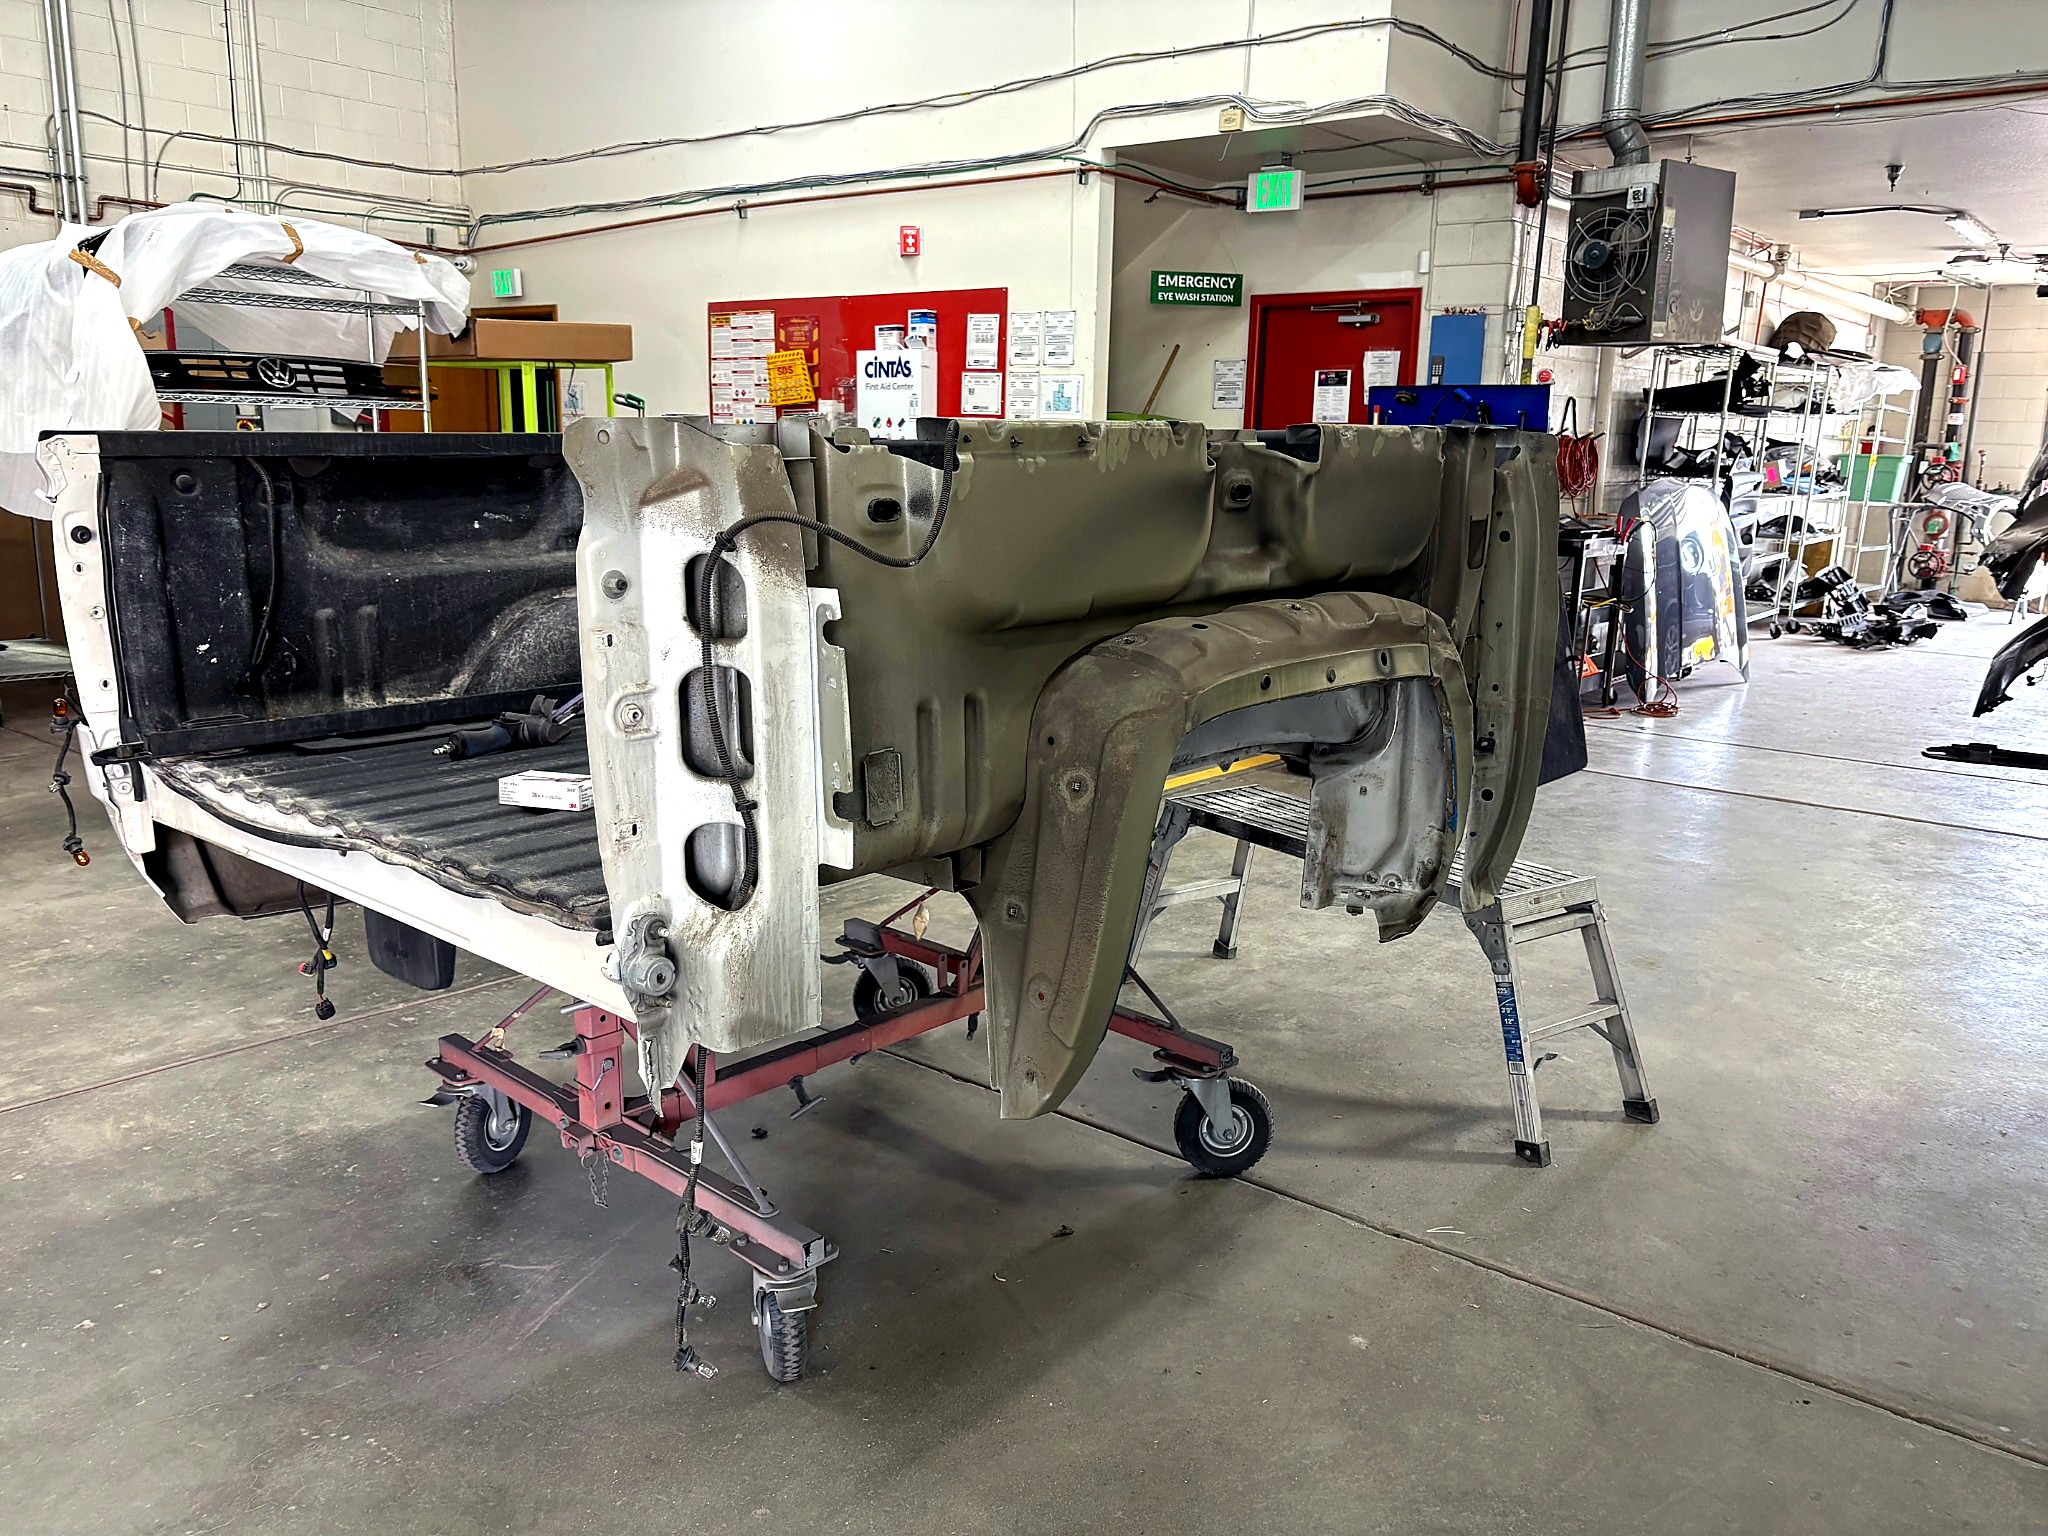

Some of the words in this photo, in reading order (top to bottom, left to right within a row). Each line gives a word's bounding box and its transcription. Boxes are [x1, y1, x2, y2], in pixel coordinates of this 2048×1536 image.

[1256, 172, 1294, 209] EXIT
[1158, 275, 1236, 289] EMERGENCY
[1158, 292, 1173, 301] EYE
[1175, 292, 1199, 301] WASH
[1201, 293, 1233, 303] STATION
[777, 366, 794, 375] SDS
